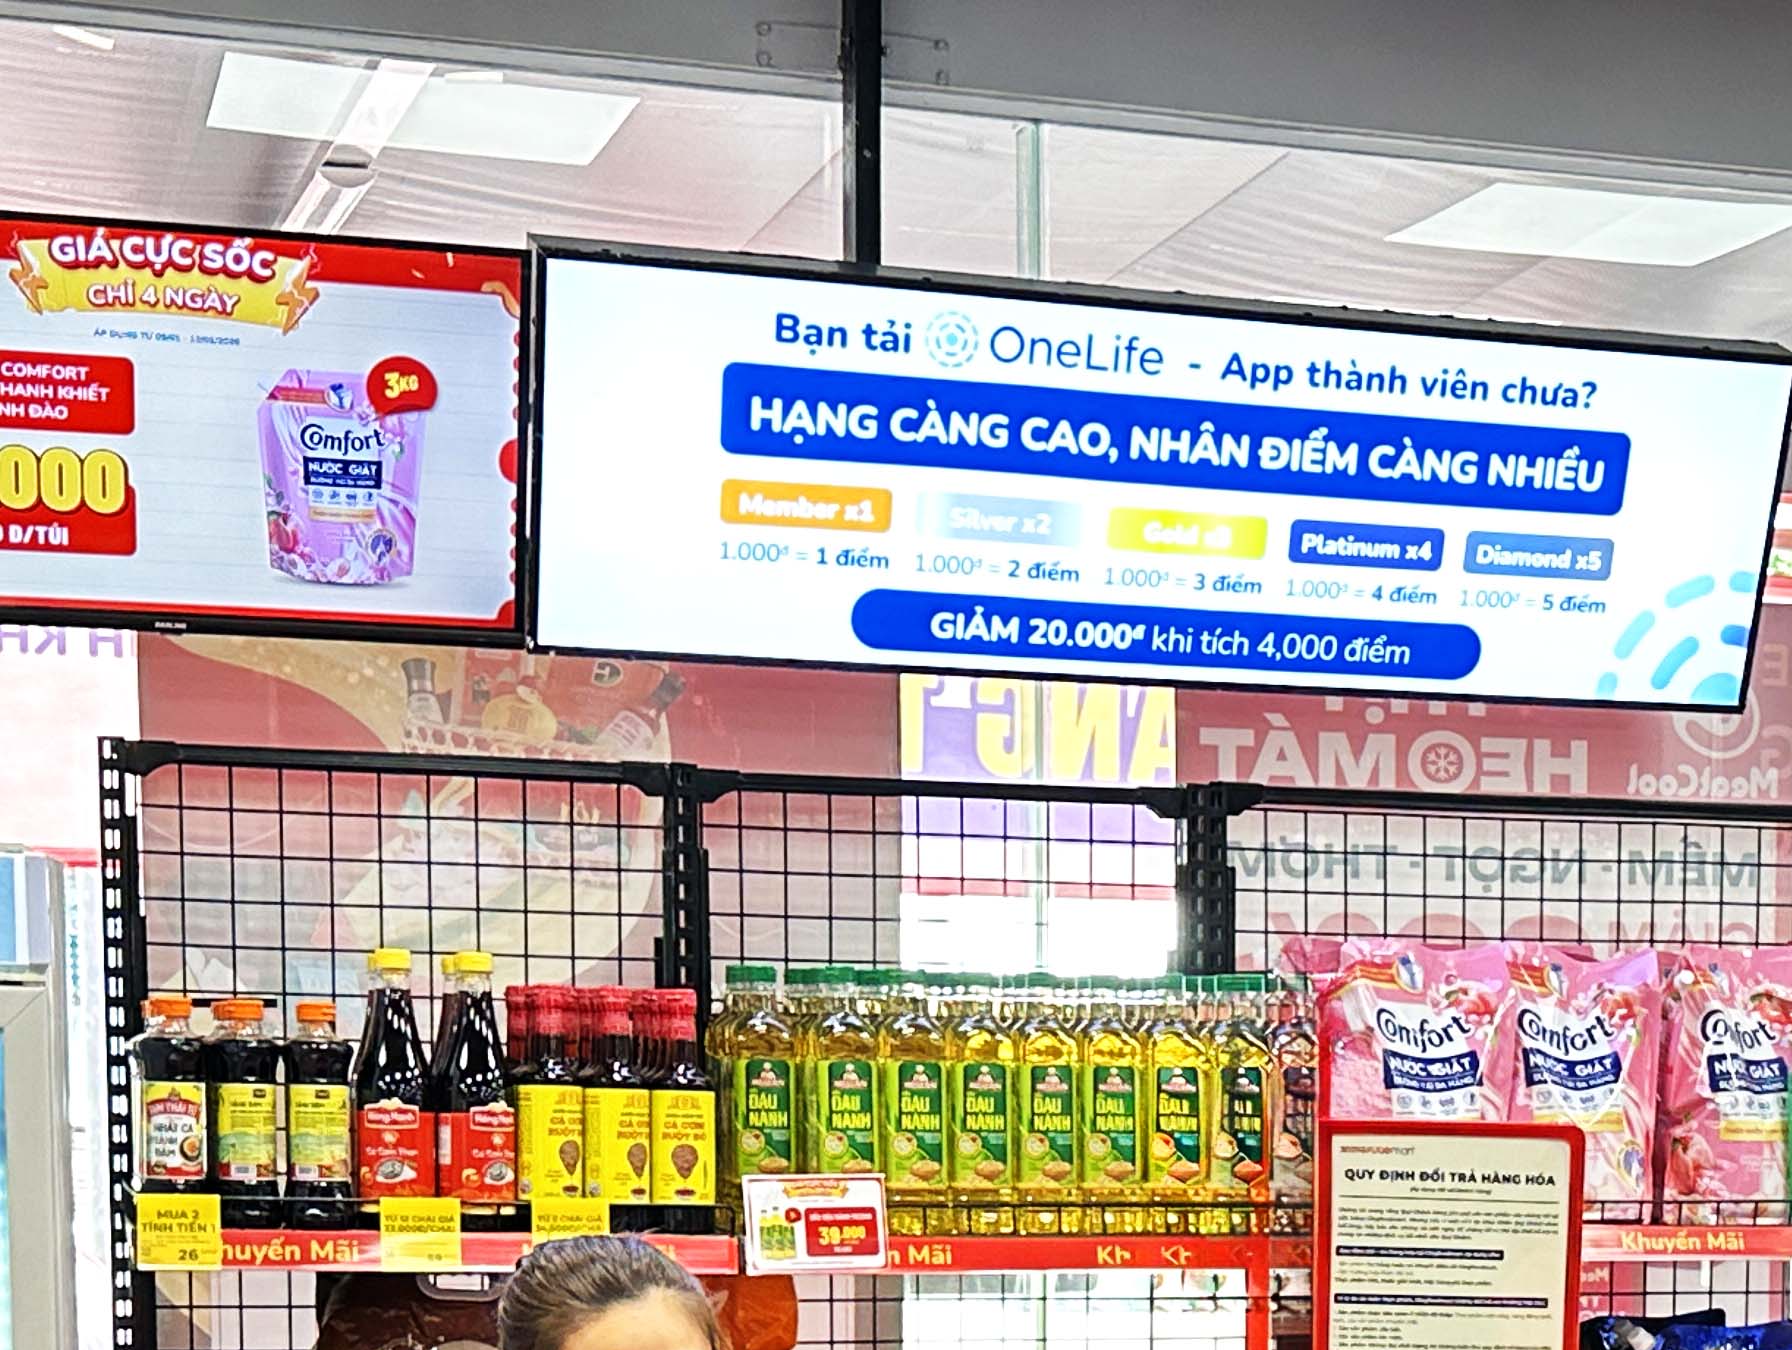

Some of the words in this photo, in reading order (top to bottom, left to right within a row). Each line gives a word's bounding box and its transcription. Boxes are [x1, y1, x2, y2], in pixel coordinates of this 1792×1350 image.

[50, 229, 115, 267] GIÁ
[121, 236, 195, 276] CỰC
[201, 235, 277, 279] SỐC
[87, 275, 135, 306] CHỈ
[139, 284, 158, 306] 4
[162, 285, 240, 315] NGÀY
[2, 361, 89, 380] COMFORT
[775, 313, 847, 355] Bạn
[863, 321, 911, 354] tải
[990, 324, 1163, 375] OneLife
[1221, 352, 1293, 391] App
[1307, 358, 1407, 395] thành
[1421, 367, 1489, 401] viên
[1501, 374, 1598, 409] chưa?
[0, 382, 53, 397] HANH
[56, 380, 110, 401] KHIẾT
[31, 401, 69, 421] ĐÀO
[300, 421, 385, 455] Comfort
[750, 395, 879, 445] HẠNG
[889, 399, 1010, 447] CÀNG
[1020, 417, 1119, 463] CAO,
[1130, 422, 1249, 469] NHÂN
[1258, 426, 1358, 475] ĐIỂM
[1368, 438, 1478, 485] CÀNG
[1488, 445, 1604, 493] NHIỀU
[738, 492, 841, 521] Member
[816, 547, 827, 566] 1
[835, 545, 889, 570] điểm
[1301, 533, 1401, 561] Platinum
[1405, 541, 1432, 561] x4
[1475, 543, 1571, 571] Diamond
[1575, 551, 1602, 571] x5
[1008, 560, 1020, 578] 2
[1027, 557, 1080, 583] điểm
[1193, 573, 1205, 591] 3
[1212, 570, 1262, 595] điểm
[1371, 585, 1383, 602] 4
[1389, 582, 1438, 606] điểm
[1542, 594, 1553, 613] 5
[1559, 590, 1606, 615] điểm
[930, 605, 1019, 644] GIẢM
[1151, 625, 1192, 653] khi
[1199, 628, 1249, 657] tích
[1257, 633, 1338, 663] 4,000
[1343, 632, 1410, 667] điểm
[1376, 1006, 1472, 1053] Comfort
[1517, 1008, 1615, 1057] Comfort
[1344, 1168, 1375, 1182] QUY
[1379, 1168, 1416, 1185] ĐỊNH
[1419, 1168, 1446, 1184] ĐỔI
[1450, 1170, 1479, 1185] TRẢ
[1481, 1170, 1522, 1186] HÀNG
[1525, 1173, 1556, 1187] HÓA
[141, 1220, 174, 1233] TÍNH
[178, 1220, 208, 1233] TIỀN
[157, 1210, 188, 1220] MUA
[221, 1236, 301, 1266] huyến
[310, 1238, 360, 1262] Mãi
[1620, 1228, 1703, 1255] Khuyến
[1707, 1228, 1746, 1252] Mãi
[178, 1248, 199, 1262] 26
[908, 1244, 953, 1266] Mãi
